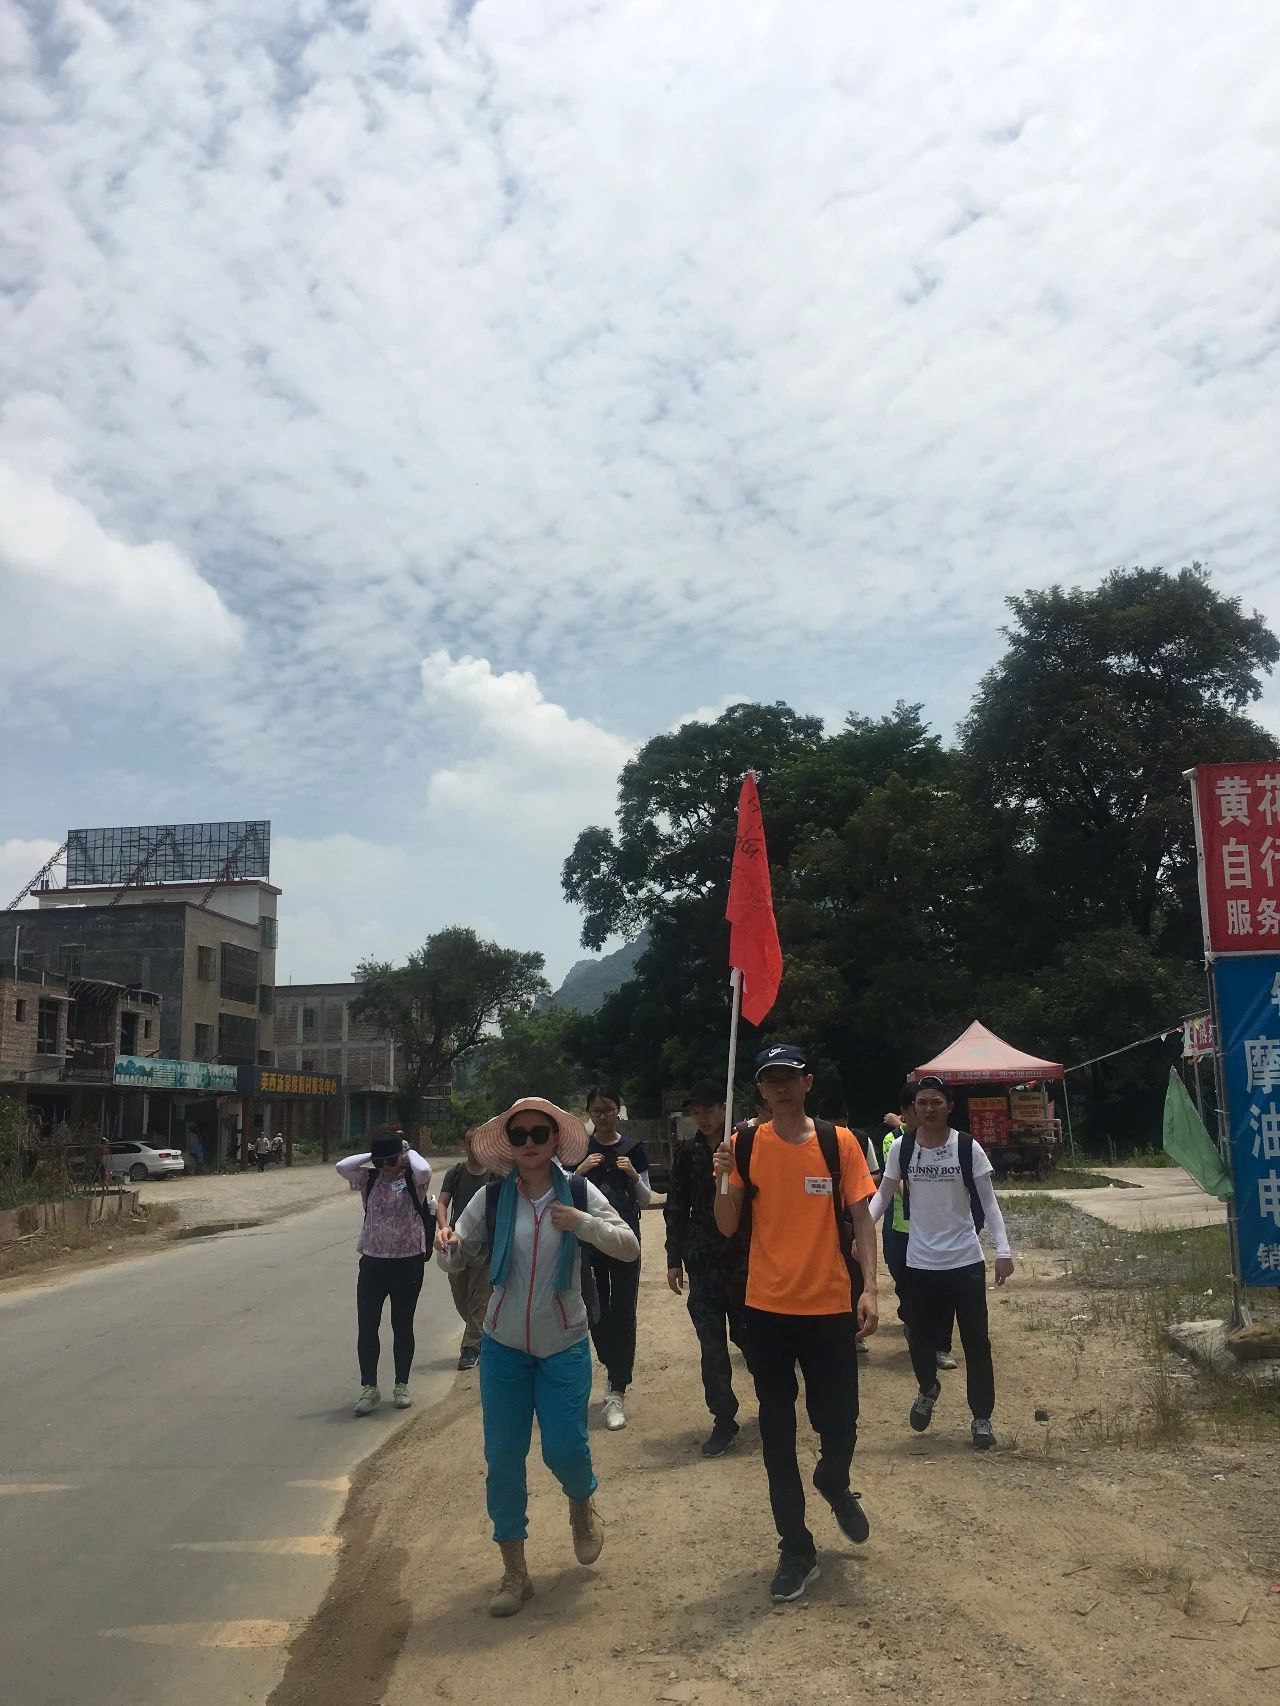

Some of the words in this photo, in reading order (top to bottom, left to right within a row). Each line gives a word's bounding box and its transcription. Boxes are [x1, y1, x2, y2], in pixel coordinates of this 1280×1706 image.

[1227, 898, 1280, 935] 服务
[907, 1165, 939, 1174] SUNNY
[940, 1165, 960, 1174] BOY
